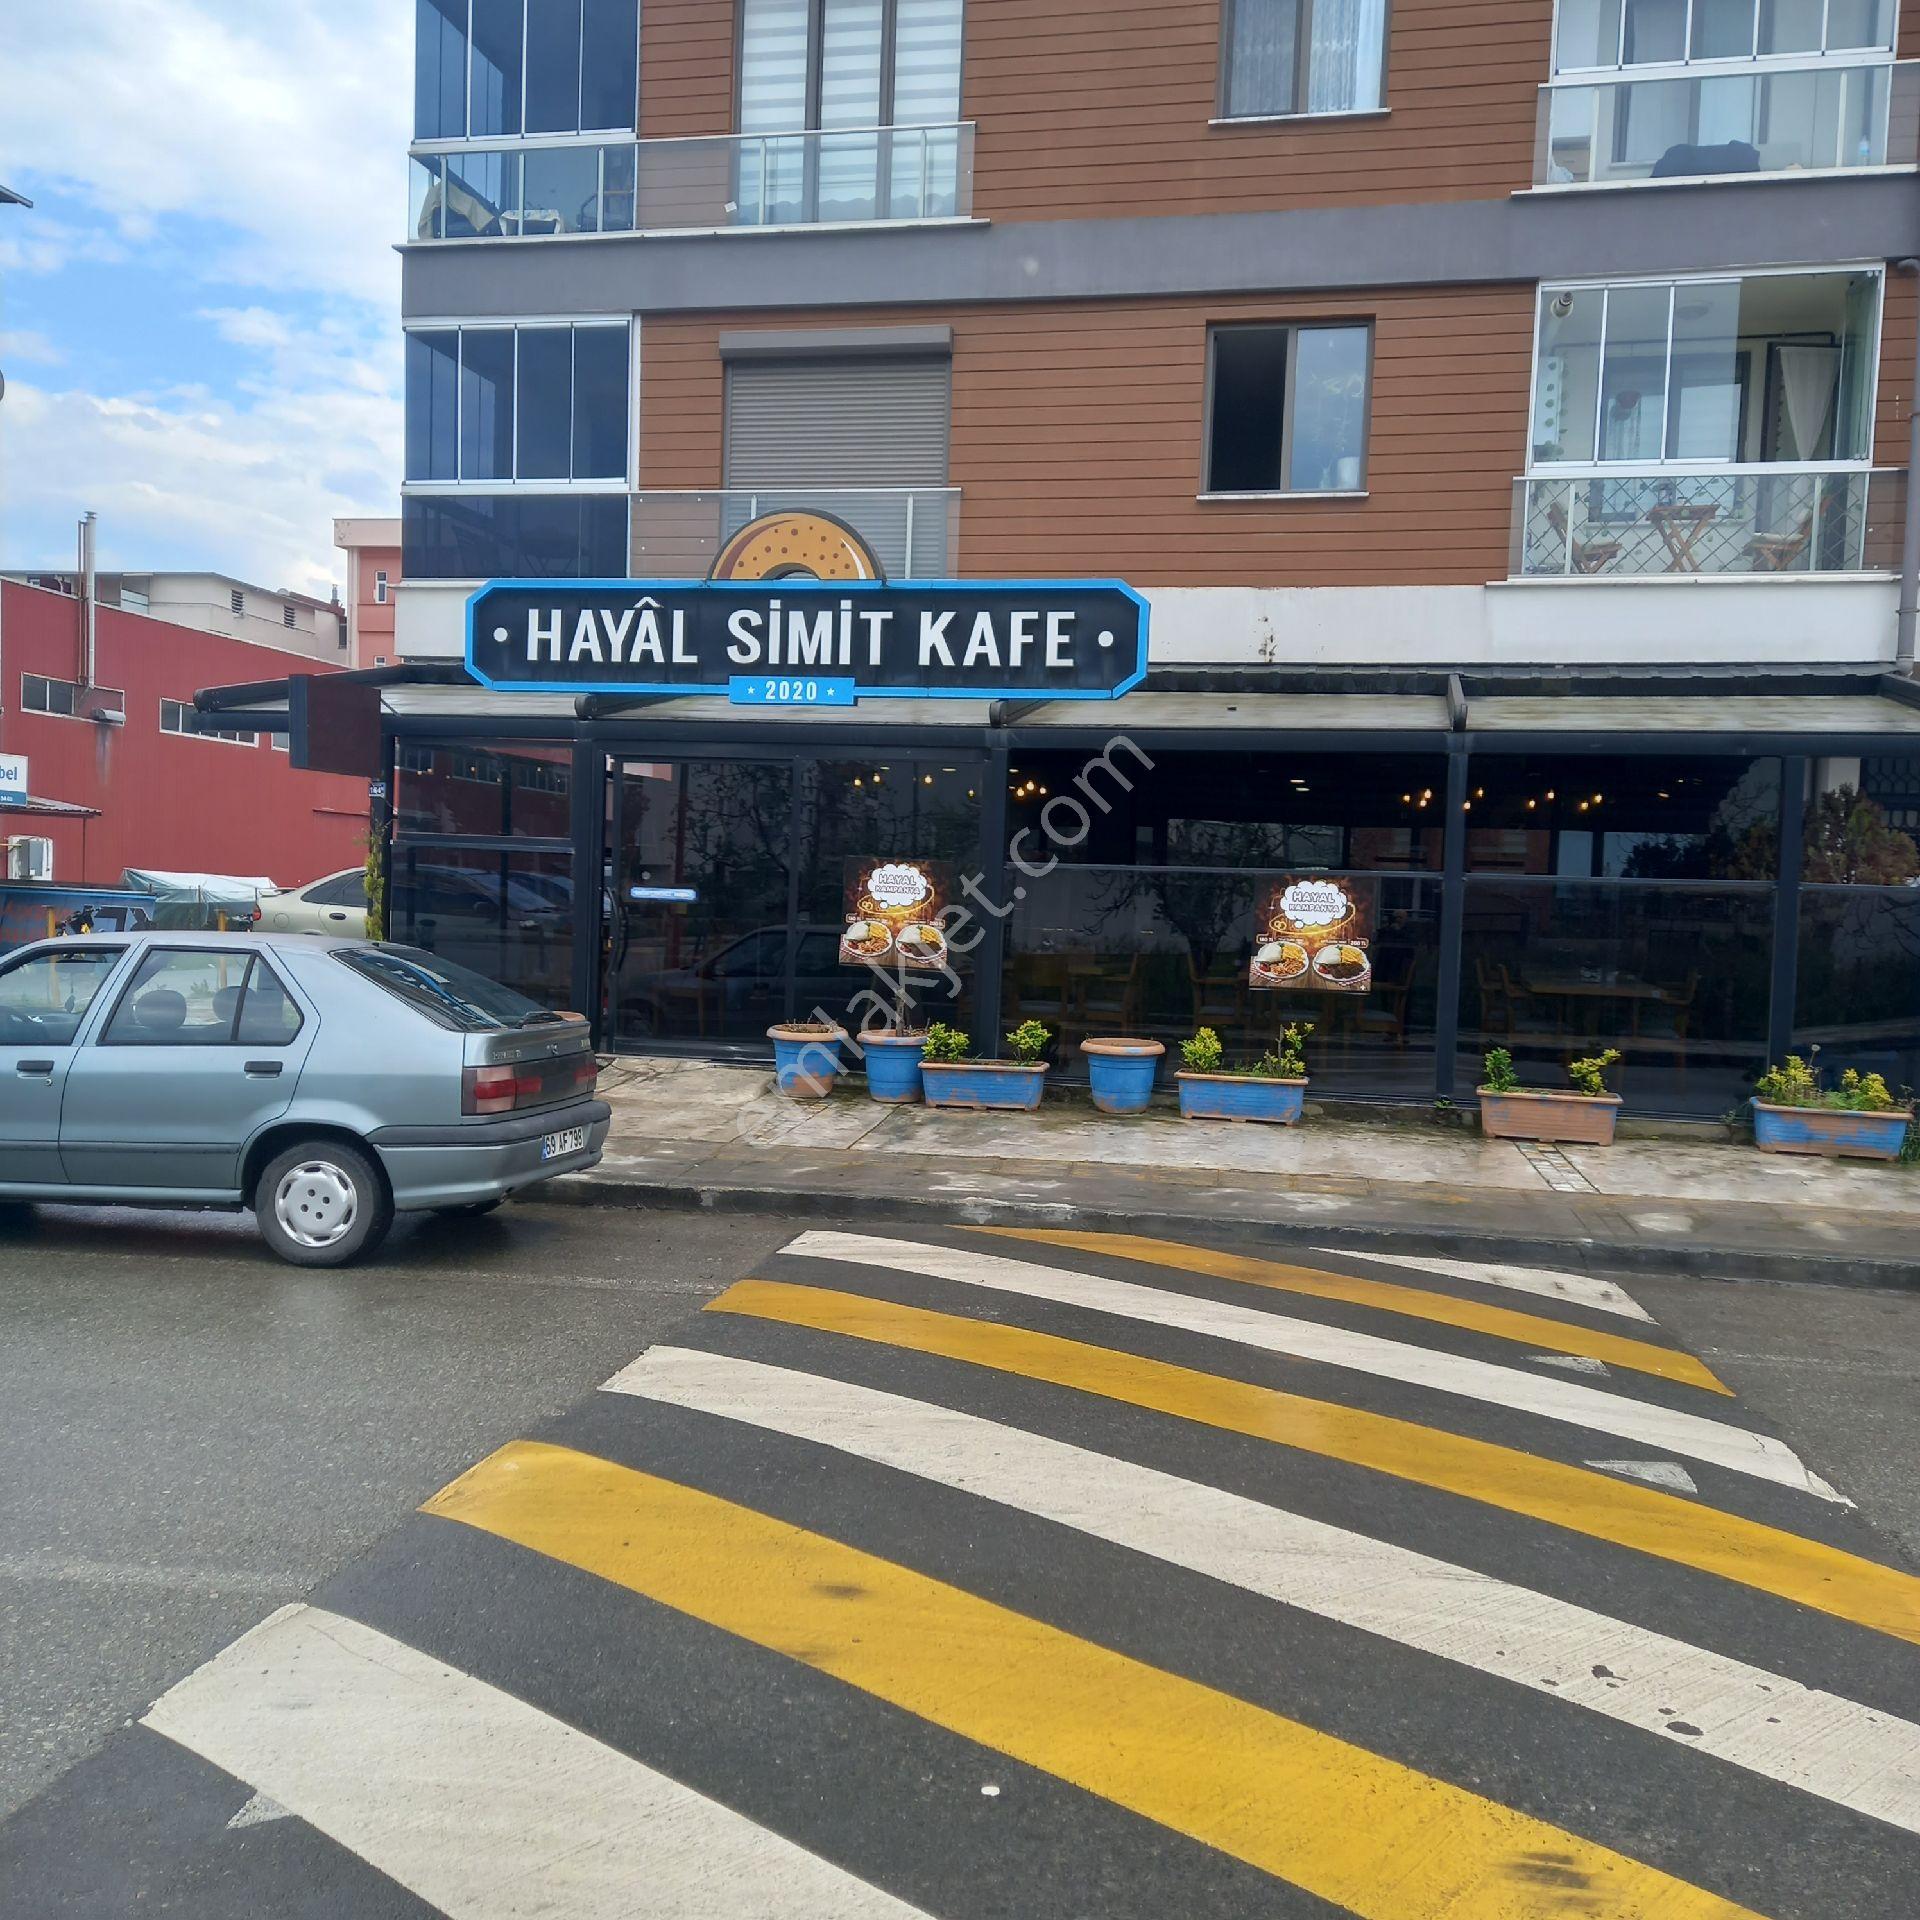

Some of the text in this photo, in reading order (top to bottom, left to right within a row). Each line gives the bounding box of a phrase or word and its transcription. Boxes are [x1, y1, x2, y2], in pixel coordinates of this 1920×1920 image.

[526, 596, 1076, 667] HAYÂL SİMİT KAFE
[765, 680, 818, 700] 2020
[879, 874, 916, 885] HAYAL
[875, 885, 920, 894] KAMPANYA
[1292, 892, 1335, 903] HAYAL
[1288, 903, 1340, 913] KAMPANYA
[559, 1133, 568, 1151] AF
